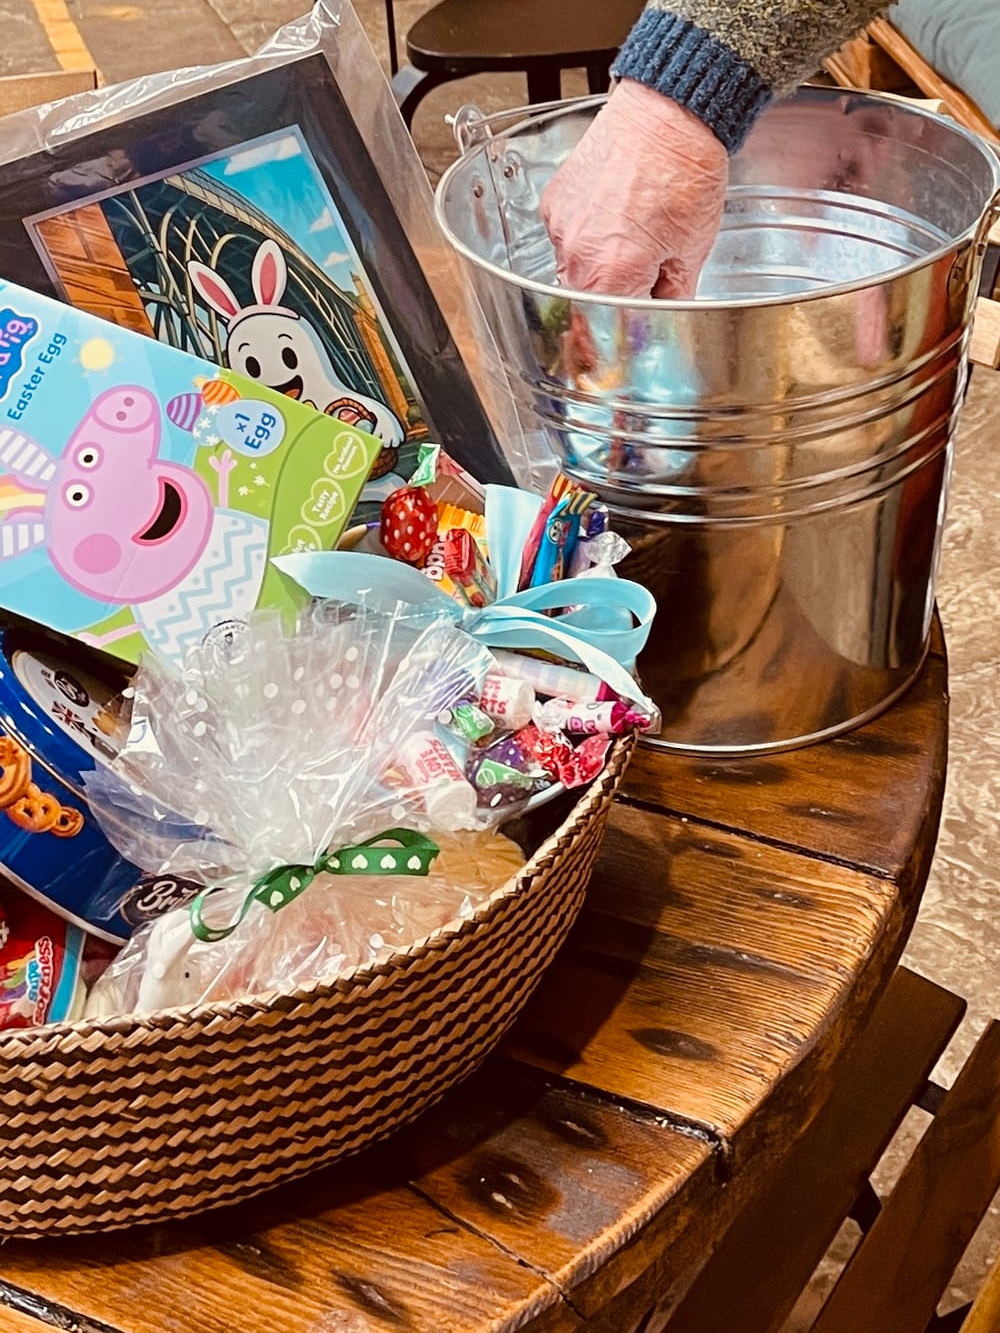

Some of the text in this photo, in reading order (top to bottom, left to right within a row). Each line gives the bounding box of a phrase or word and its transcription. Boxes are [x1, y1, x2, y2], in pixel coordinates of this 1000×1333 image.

[7, 332, 67, 421] Easter Egg
[234, 412, 251, 433] x1
[244, 412, 277, 450] Egg
[311, 489, 330, 514] Tasty
[319, 491, 339, 520] Recipe
[34, 936, 51, 1024] softness
